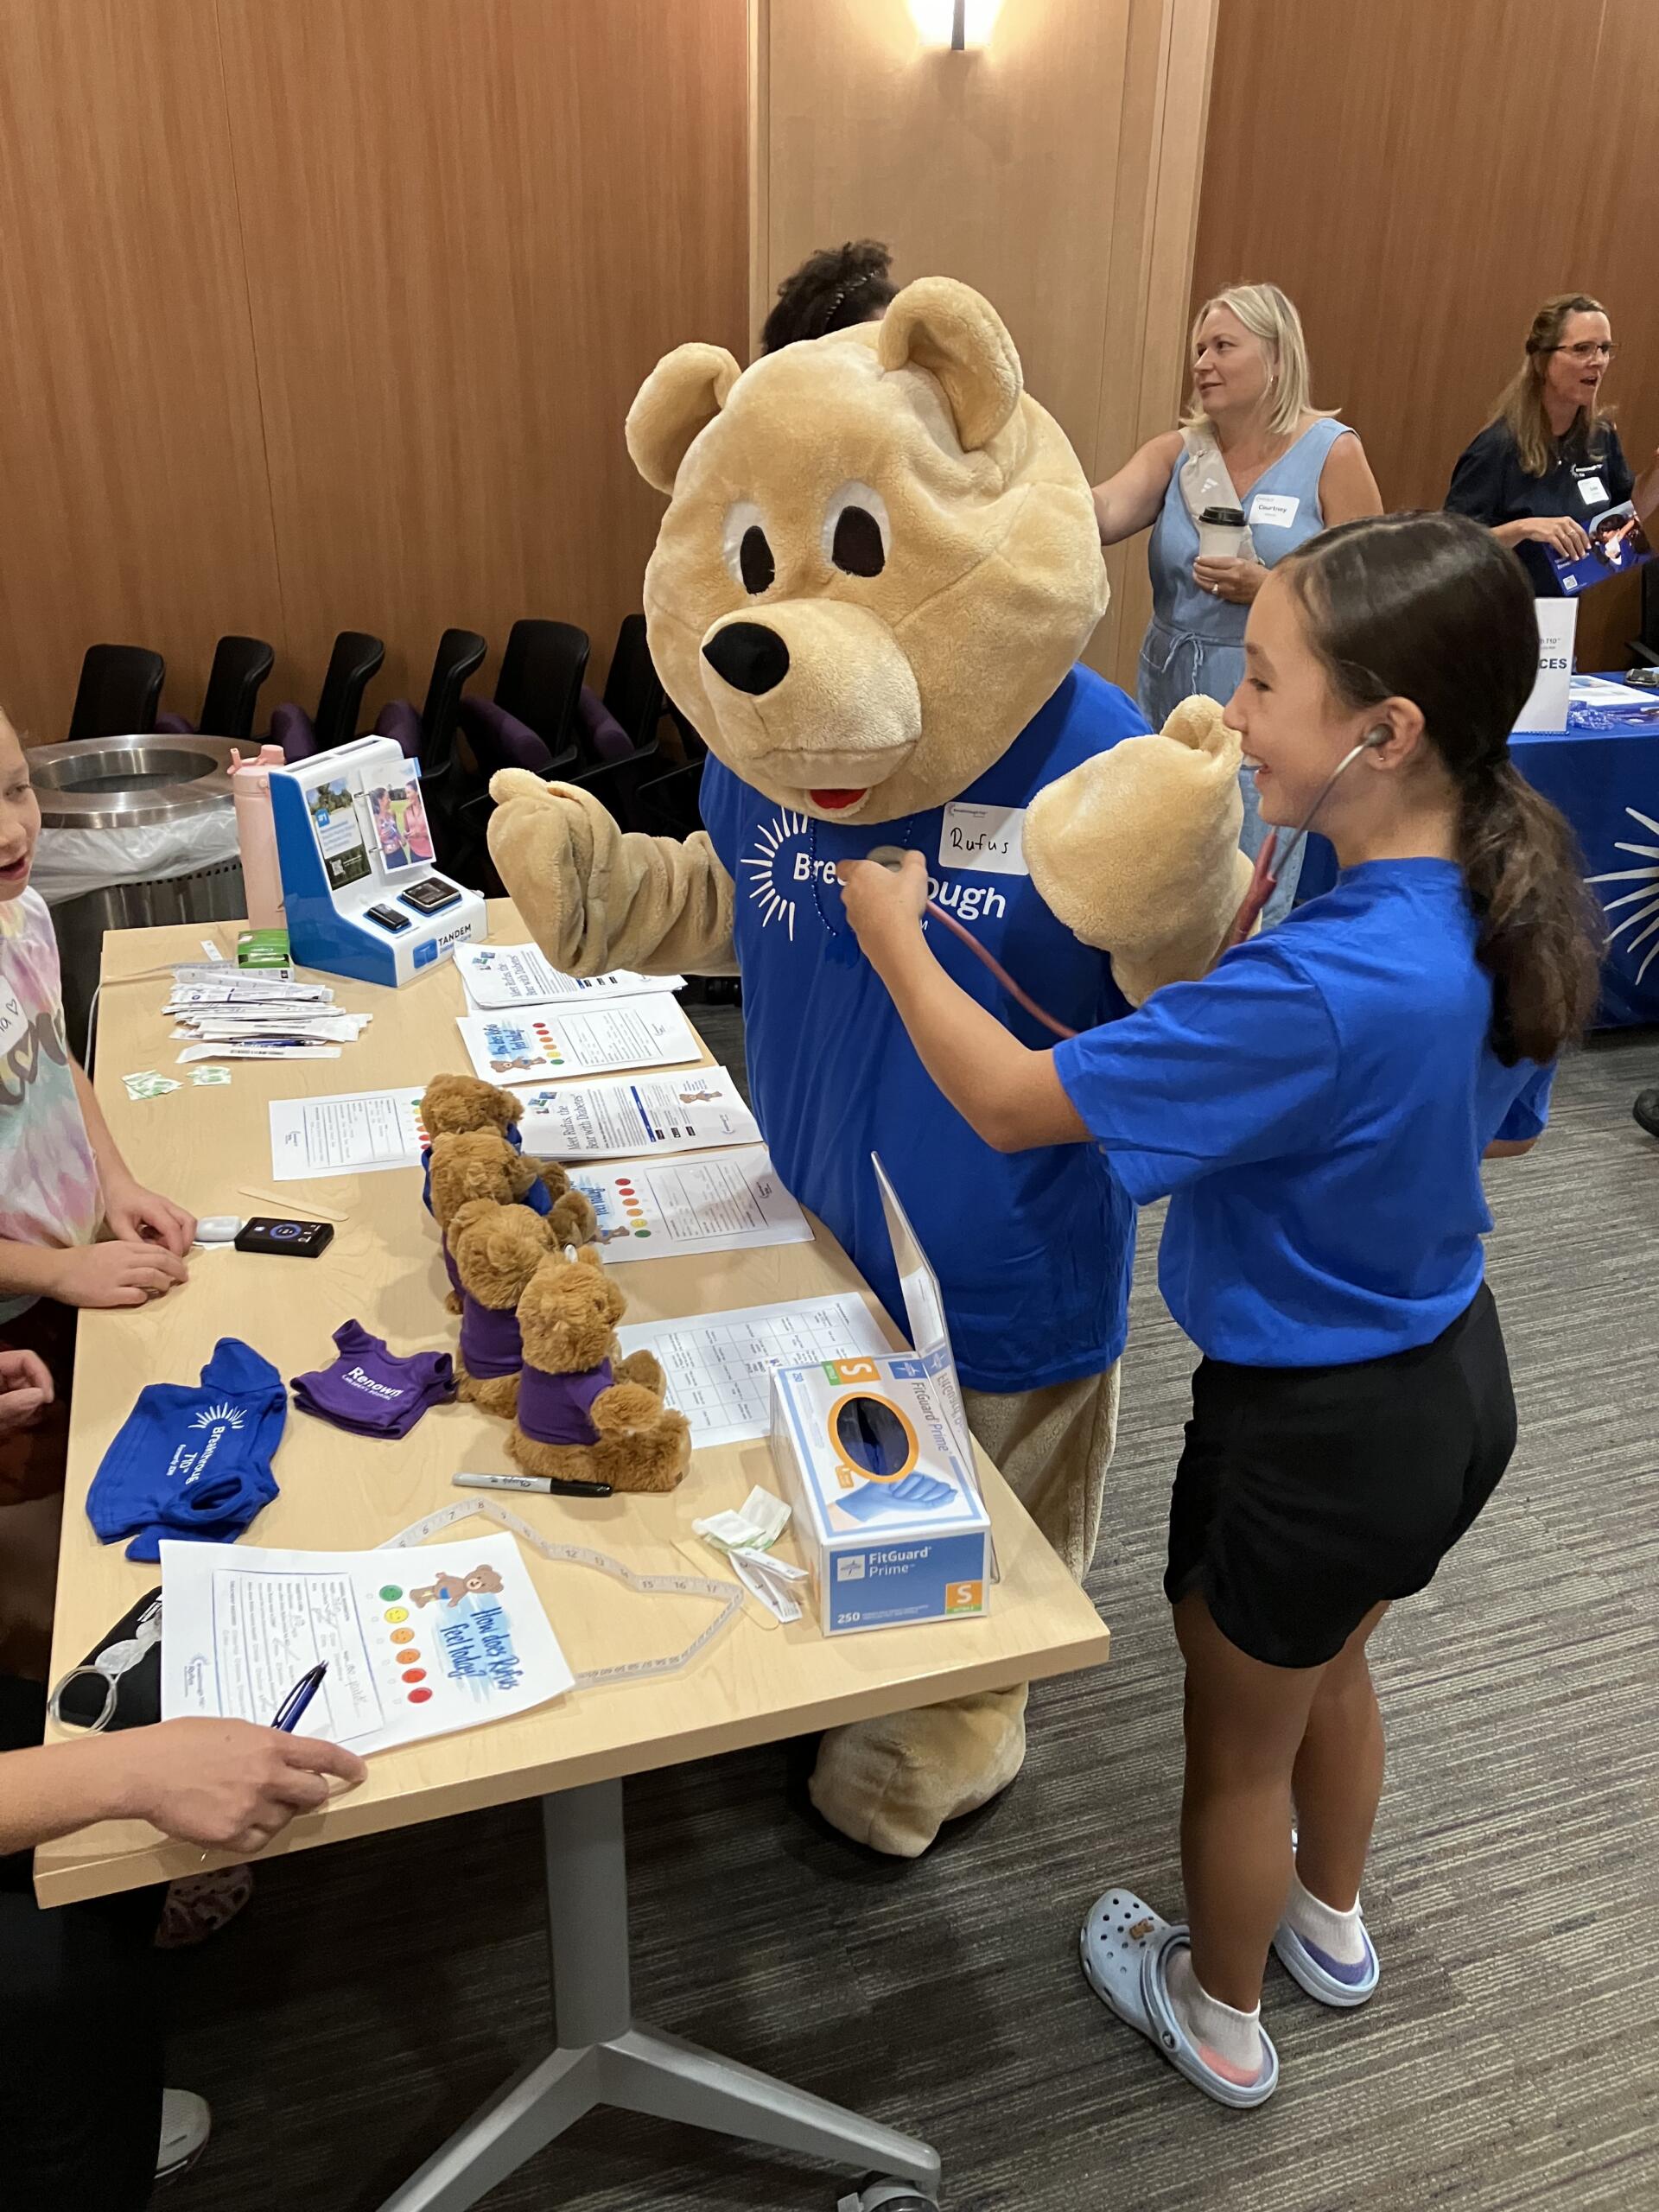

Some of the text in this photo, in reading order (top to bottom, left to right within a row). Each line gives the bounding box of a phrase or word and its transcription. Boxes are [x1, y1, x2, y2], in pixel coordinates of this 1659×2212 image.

[950, 827, 1009, 854] Rufus
[439, 923, 472, 946] TANDEM
[841, 1363, 873, 1376] S
[347, 1366, 405, 1398] Renown
[930, 1423, 949, 1452] Prime
[448, 1511, 455, 1521] 7
[422, 1524, 429, 1535] 6
[642, 1580, 655, 1589] 15
[674, 1580, 687, 1590] 16
[956, 1584, 973, 1605] S
[836, 1611, 861, 1624] 250
[439, 1623, 488, 1680] feel today?
[469, 1605, 524, 1690] How does Rufus
